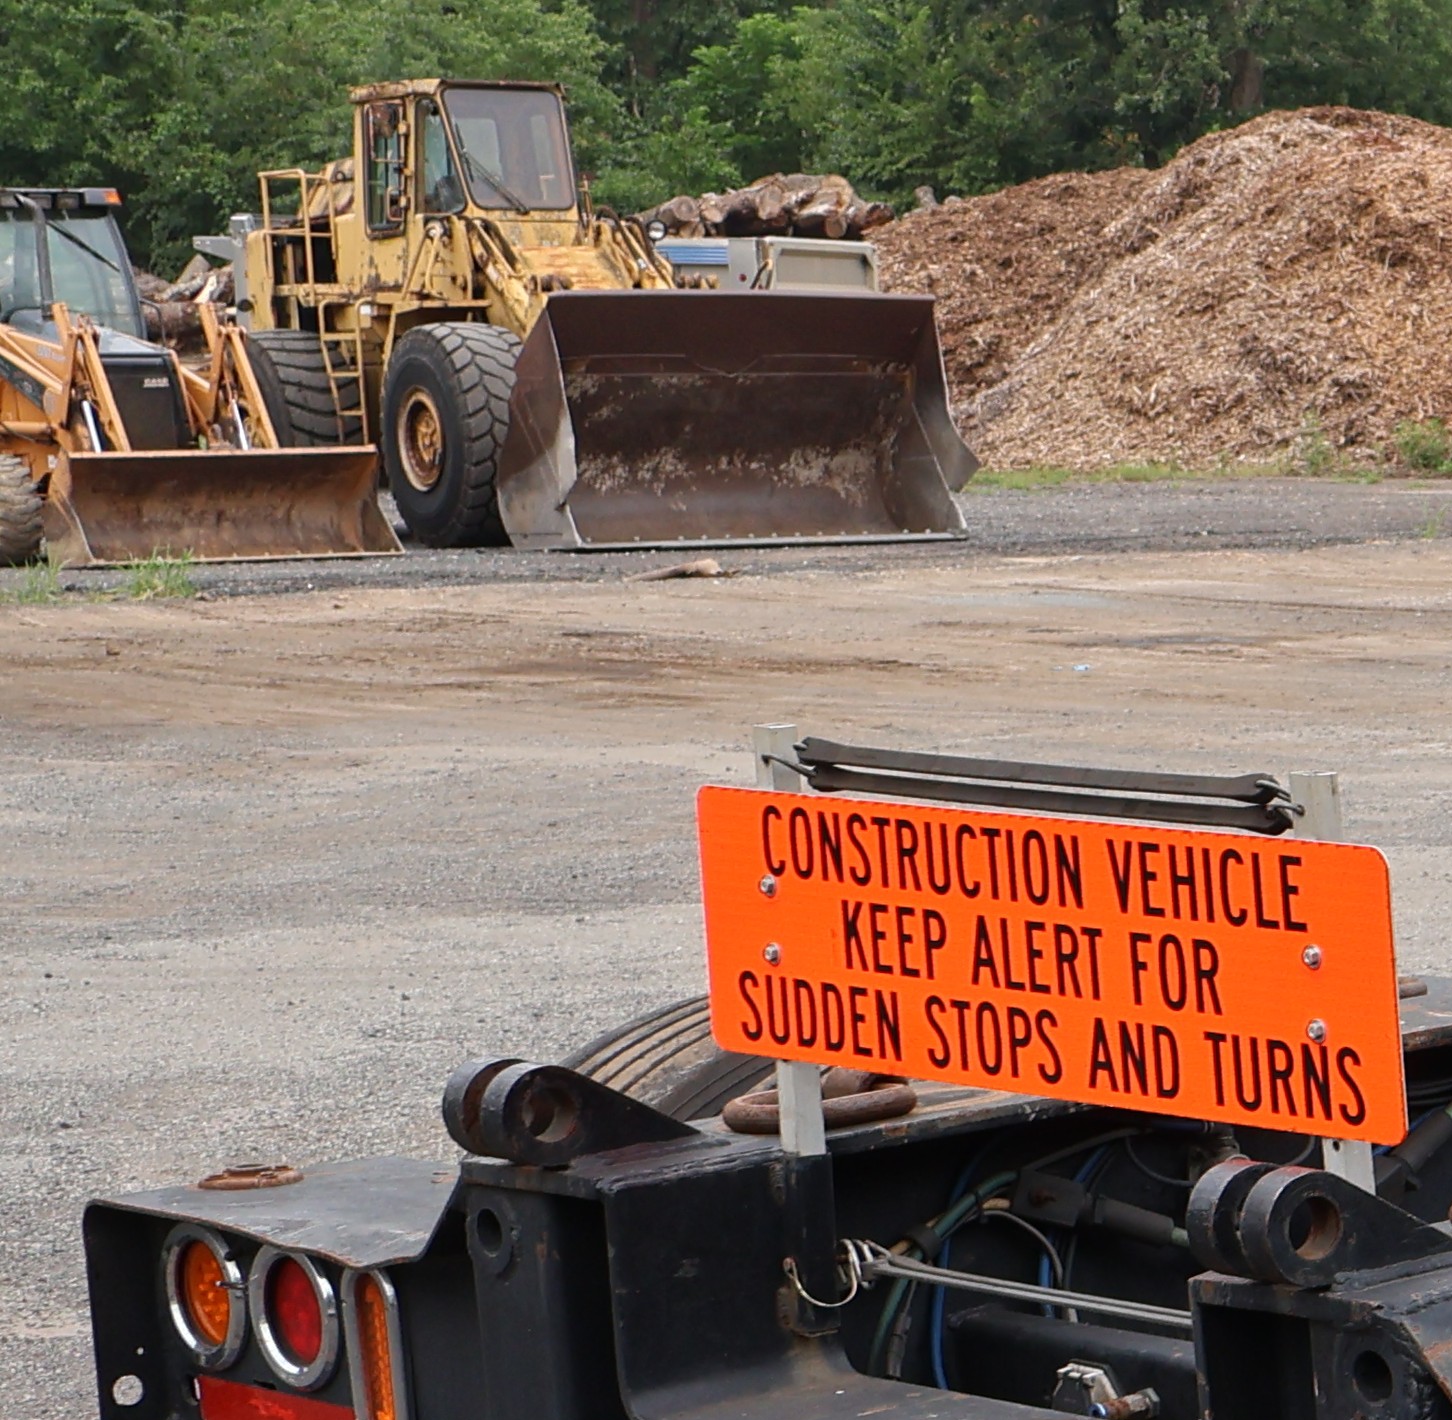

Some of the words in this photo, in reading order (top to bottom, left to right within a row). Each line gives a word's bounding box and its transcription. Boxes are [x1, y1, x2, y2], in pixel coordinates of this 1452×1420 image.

[762, 804, 1083, 908] CONSTRUCTION
[1106, 839, 1309, 933] VEHICLE
[842, 900, 948, 980] KEEP
[972, 915, 1103, 1001] ALERT
[1130, 932, 1223, 1015] FOR
[739, 969, 903, 1062] SUDDEN
[925, 995, 1063, 1085] STOPS
[1089, 1017, 1181, 1099] AND
[1203, 1030, 1367, 1126] TURNS
